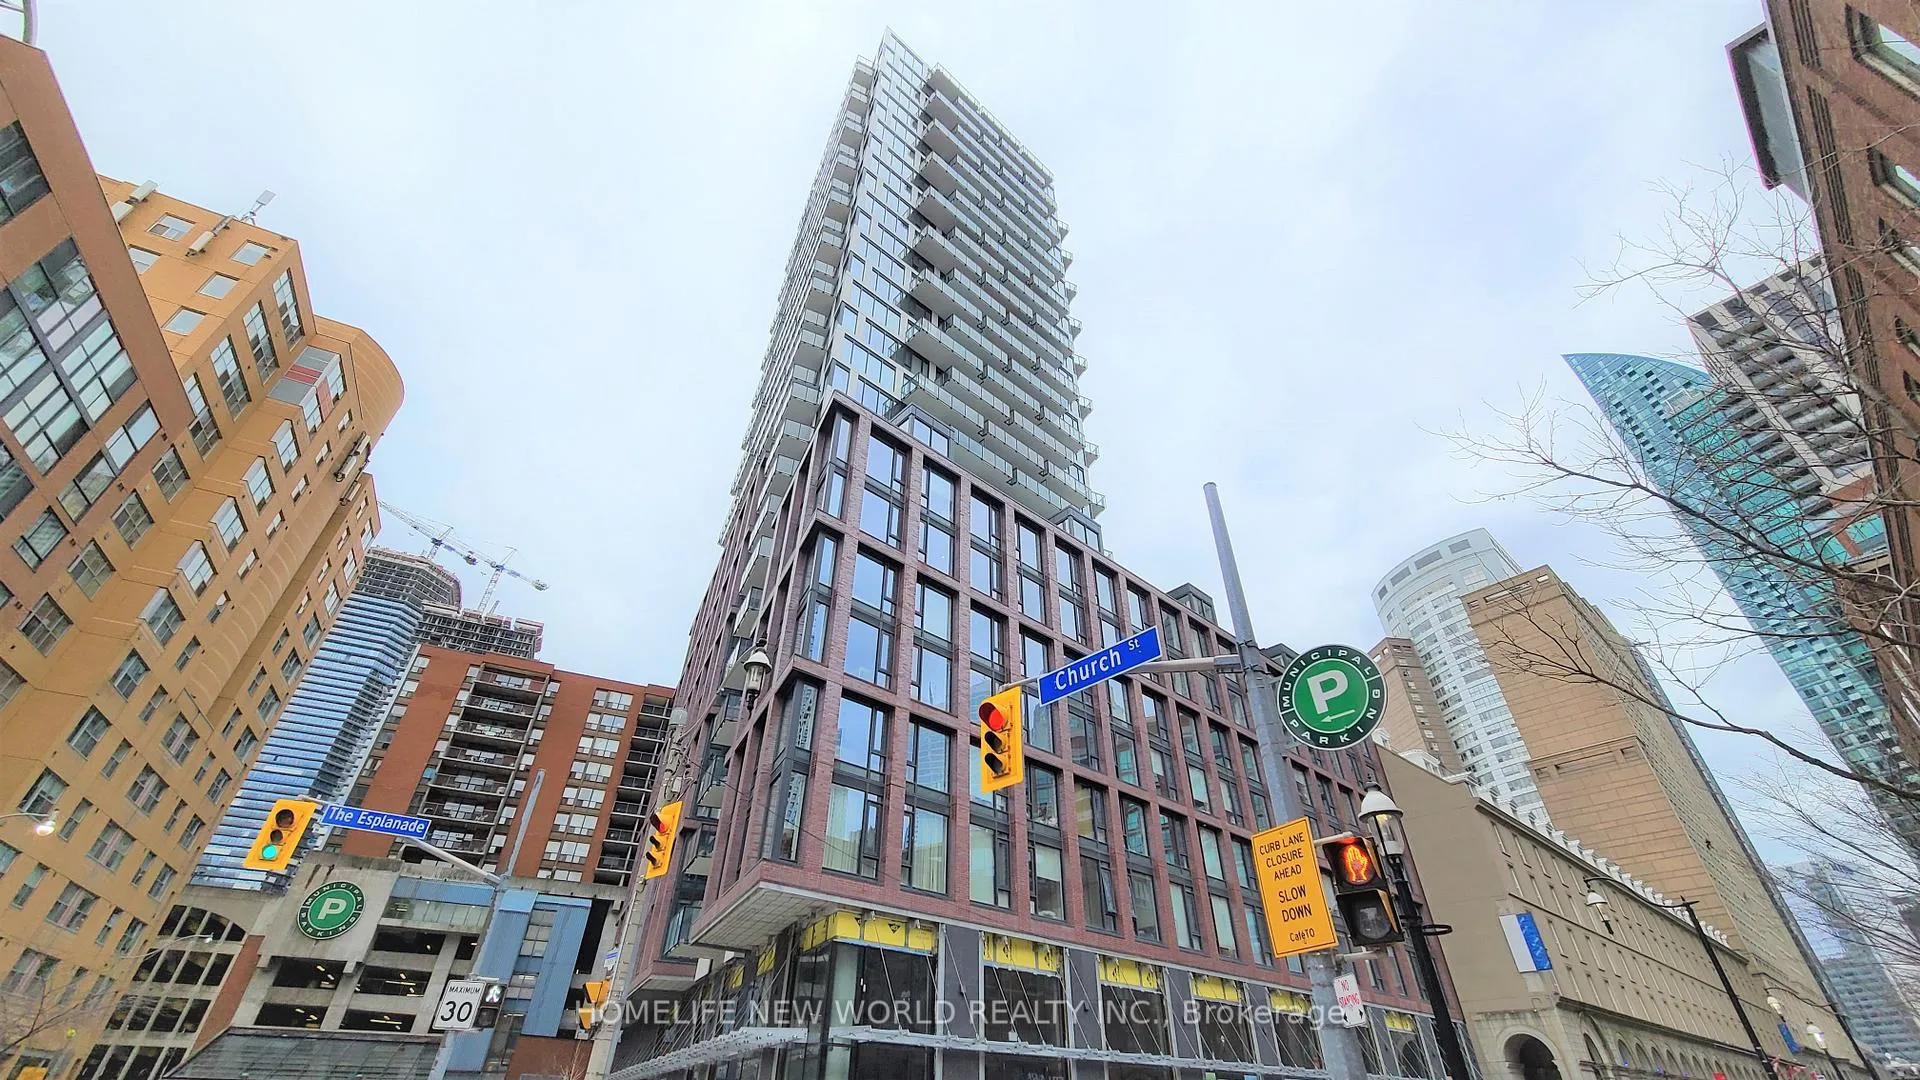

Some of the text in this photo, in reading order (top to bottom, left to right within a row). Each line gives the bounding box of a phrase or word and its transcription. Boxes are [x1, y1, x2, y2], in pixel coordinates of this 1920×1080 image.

[1055, 638, 1140, 690] Church St
[1282, 649, 1372, 707] MUNICIPAL
[1307, 670, 1349, 715] P
[1289, 688, 1380, 745] PARKING
[328, 806, 425, 833] The Esplanade
[1259, 832, 1305, 855] CURB LANE
[1266, 847, 1304, 868] CLOSURE
[1274, 864, 1302, 881] AHEAD
[305, 883, 363, 910] MUNICIPAL
[1278, 884, 1307, 904] SLOW
[317, 897, 347, 920] P
[1281, 903, 1313, 923] DOWN
[301, 912, 356, 937] PARKING
[448, 985, 481, 994] MAXIMUM
[440, 1000, 473, 1022] 30
